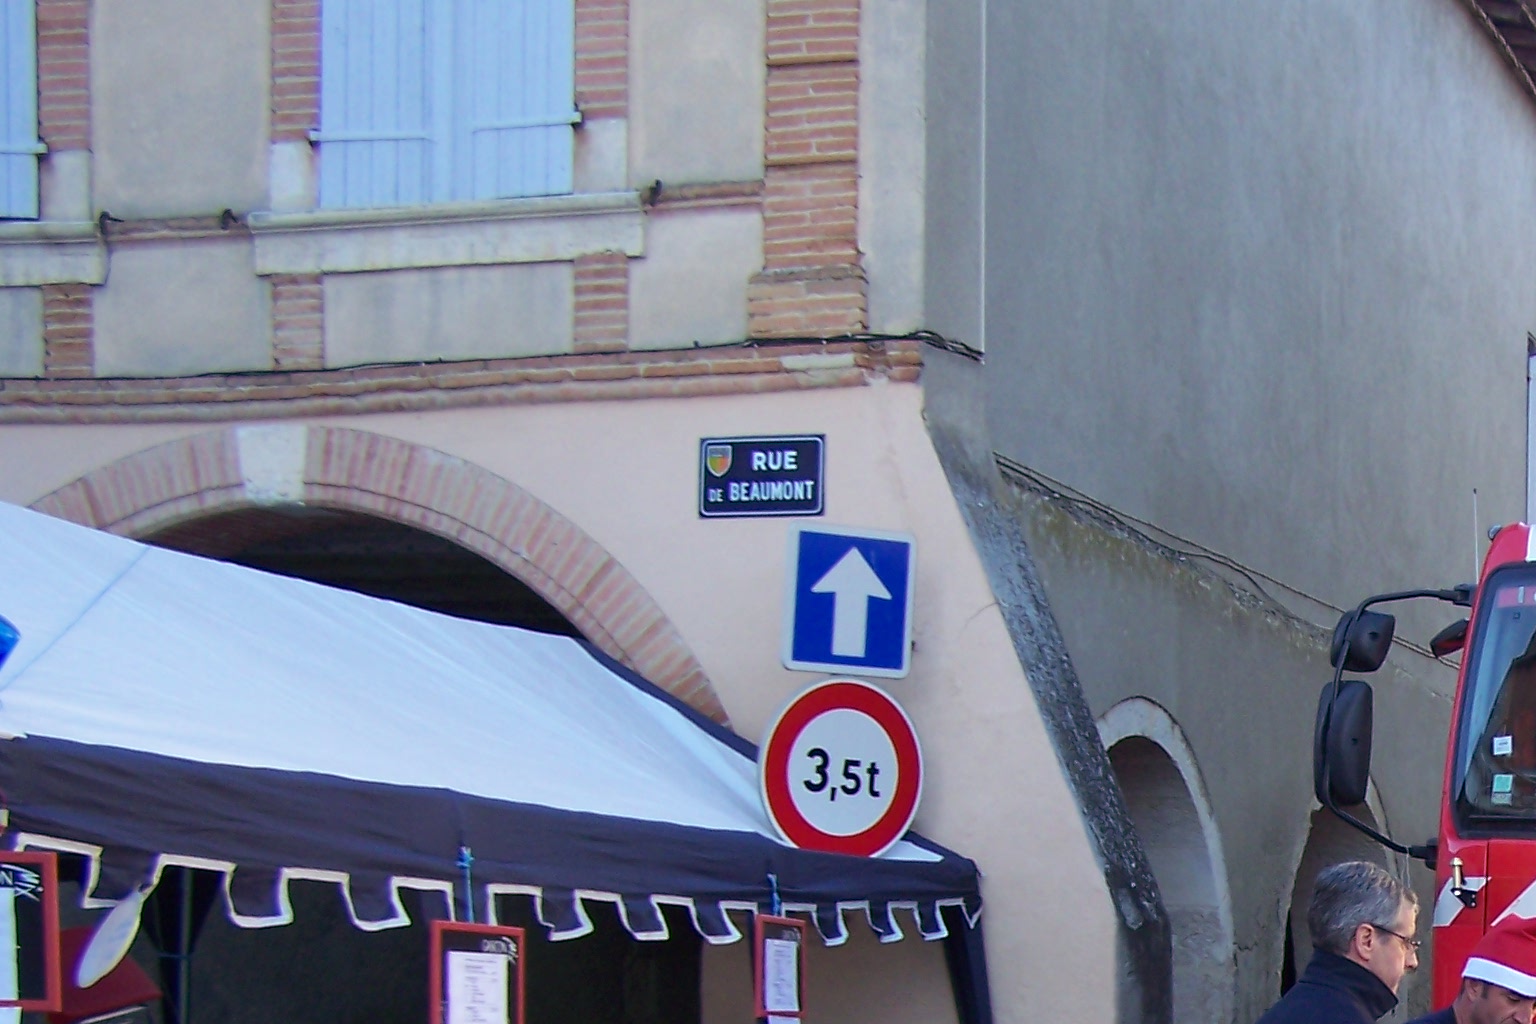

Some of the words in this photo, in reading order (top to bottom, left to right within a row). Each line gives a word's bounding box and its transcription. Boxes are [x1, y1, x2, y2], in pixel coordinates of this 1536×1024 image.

[751, 450, 798, 472] RUE
[709, 487, 724, 504] DE
[729, 479, 815, 503] BEAUMONT
[802, 747, 882, 802] 3,5t
